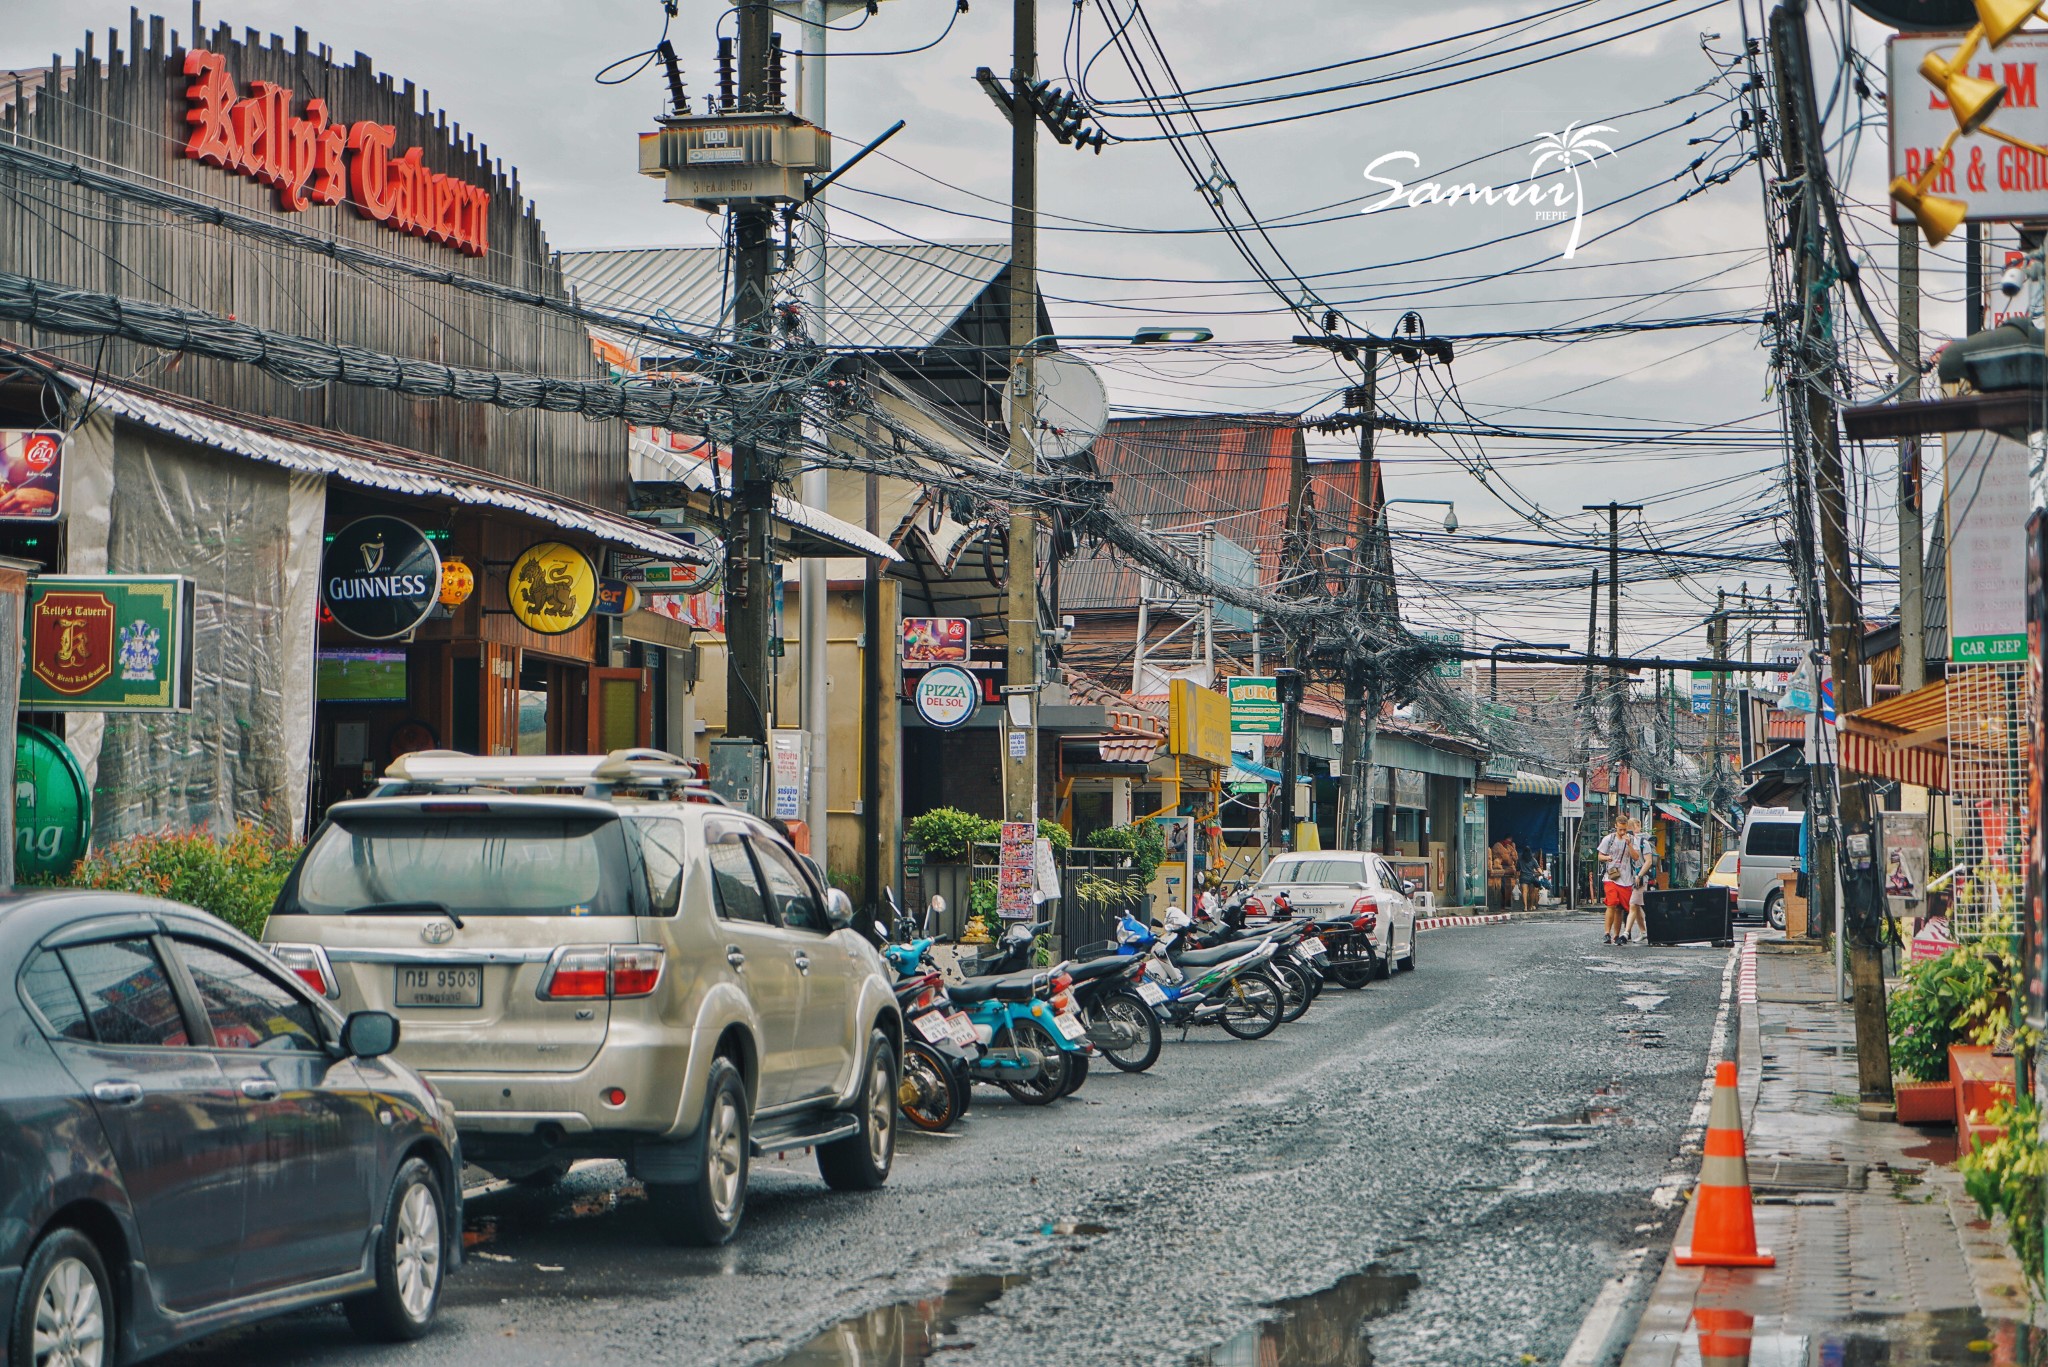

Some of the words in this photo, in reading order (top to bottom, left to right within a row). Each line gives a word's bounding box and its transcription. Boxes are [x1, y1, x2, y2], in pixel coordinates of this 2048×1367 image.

[705, 131, 726, 142] 100
[184, 49, 346, 212] Kelly's
[349, 121, 490, 257] Tavern
[1966, 145, 1988, 193] &
[329, 574, 426, 600] GUINNESS
[41, 604, 73, 617] Kelly's
[75, 605, 107, 617] Tavern
[1960, 642, 1986, 655] CAR
[1989, 639, 2021, 653] JEEP
[925, 684, 966, 698] PIZZA
[926, 697, 944, 706] DEL
[946, 698, 963, 707] SOL
[405, 970, 428, 987] กย
[437, 970, 476, 987] 9503
[931, 1027, 948, 1040] 414
